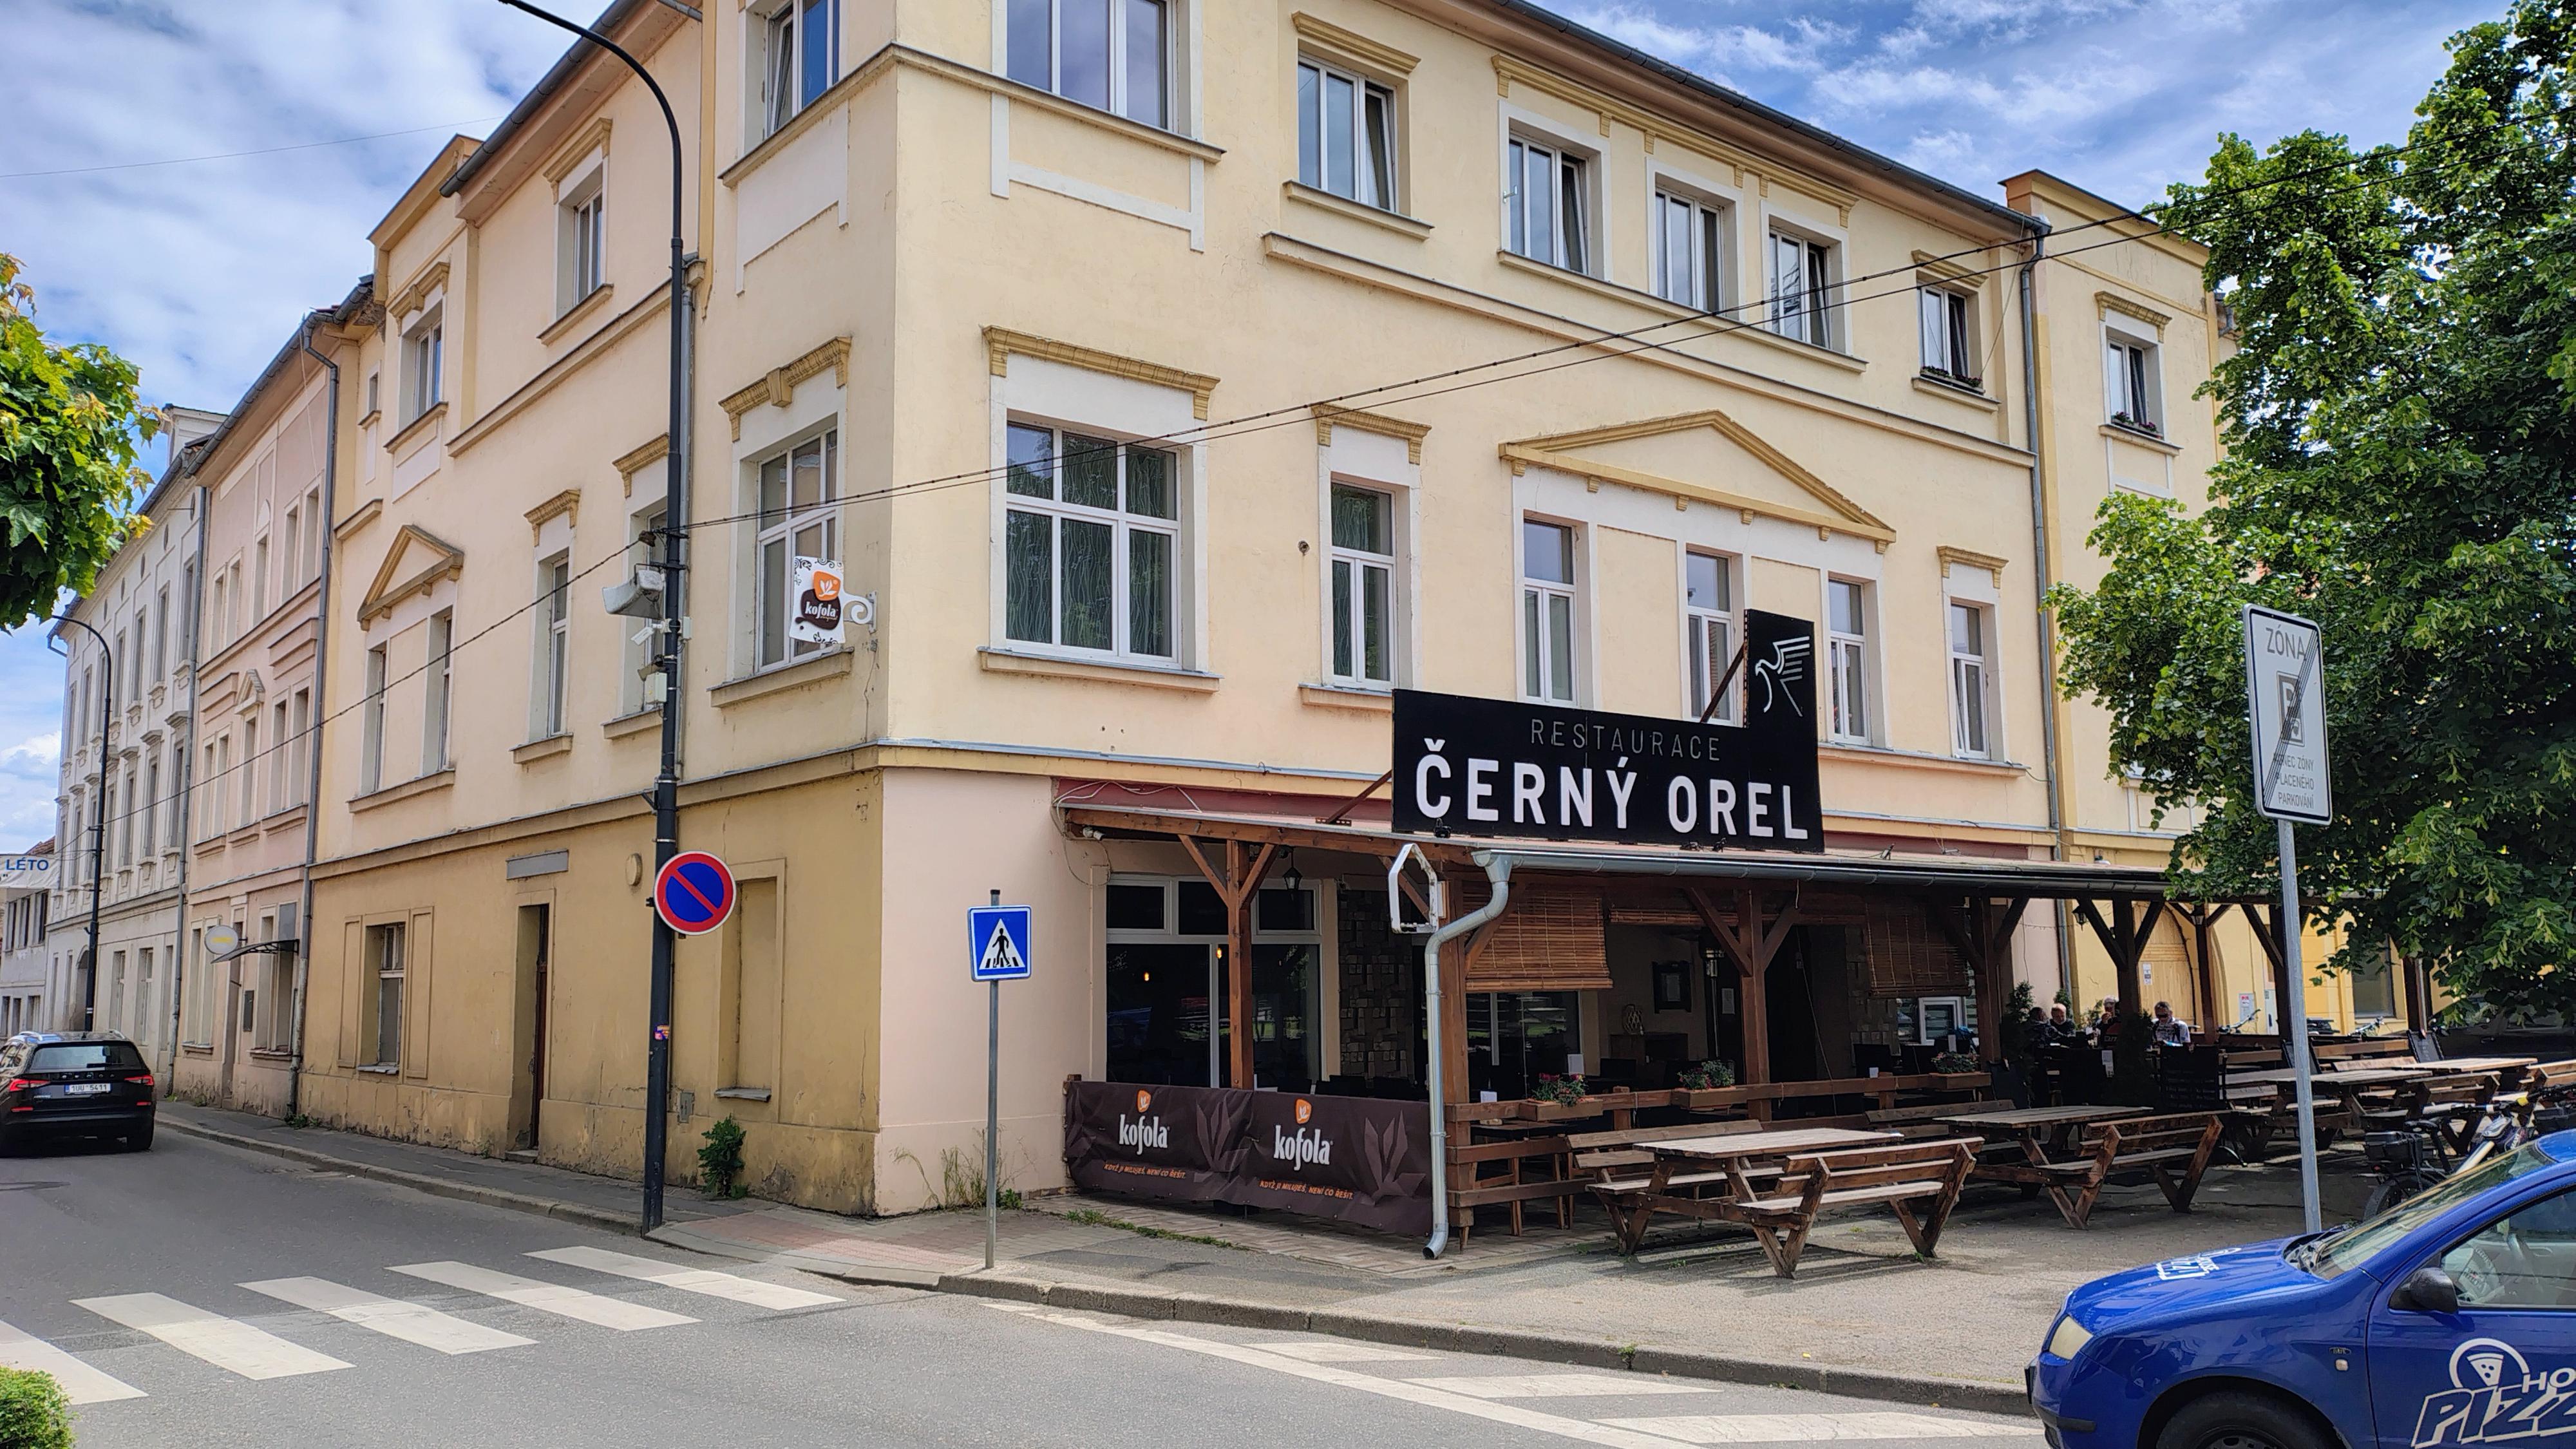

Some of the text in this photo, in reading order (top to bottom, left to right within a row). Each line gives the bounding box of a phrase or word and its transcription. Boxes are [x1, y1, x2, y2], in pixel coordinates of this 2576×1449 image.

[805, 601, 836, 619] kofola
[2266, 624, 2306, 659] ZÓNA
[1531, 719, 1720, 761] RESTAURACE
[2297, 755, 2314, 772] ZÓNY
[1417, 738, 1808, 840] ČERNÝ OREL
[2278, 791, 2315, 810] PARKOVÁNÍ
[6, 857, 49, 871] LÉTO
[1119, 1114, 1168, 1155] kofola
[1274, 1125, 1330, 1171] kofola
[1309, 1186, 1324, 1195] NENÍ
[2521, 1367, 2576, 1393] HO
